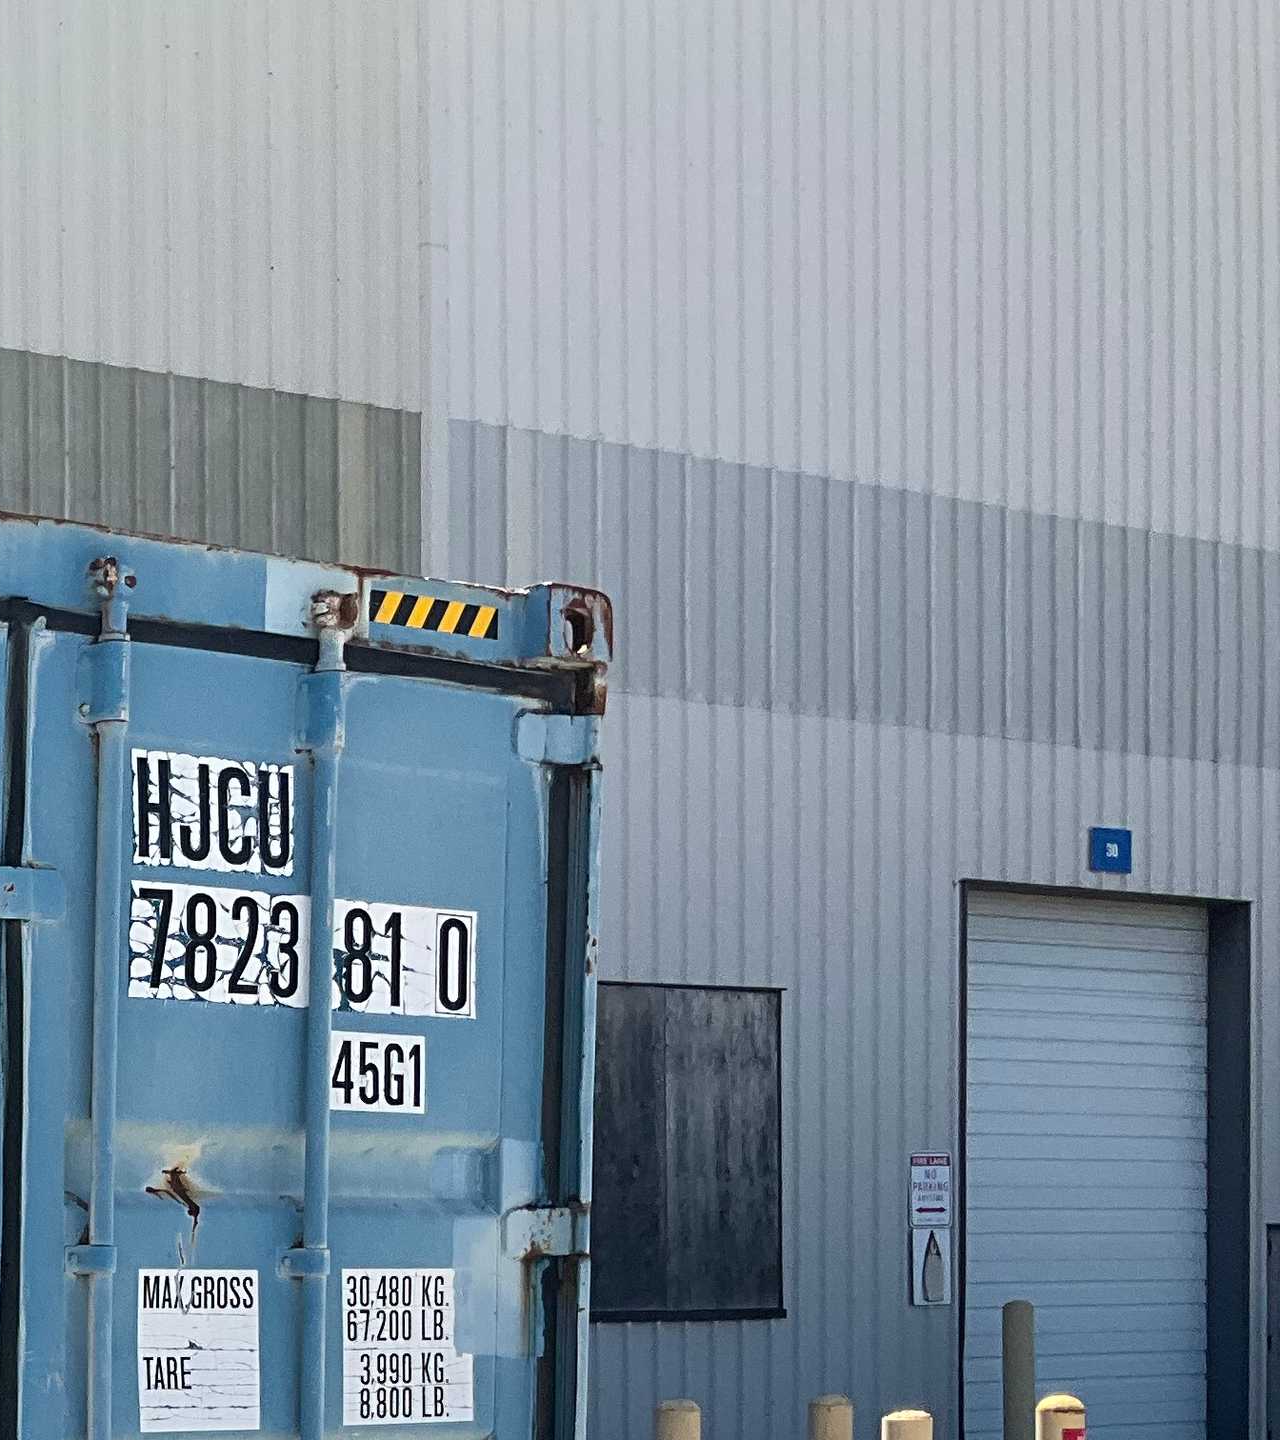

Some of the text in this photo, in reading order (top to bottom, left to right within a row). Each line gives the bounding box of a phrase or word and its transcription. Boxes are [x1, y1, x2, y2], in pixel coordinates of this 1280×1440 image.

[137, 757, 290, 868] HJCU
[331, 1039, 421, 1107] 45G1
[913, 1181, 949, 1192] PARKING
[924, 1168, 937, 1180] NO
[347, 1275, 449, 1308] 30,480 KG.
[347, 1309, 449, 1342] 67,200 LB.
[143, 1356, 192, 1390] TARE
[360, 1352, 449, 1386] 3,990 KG.
[360, 1386, 449, 1419] 8,800 LB.
